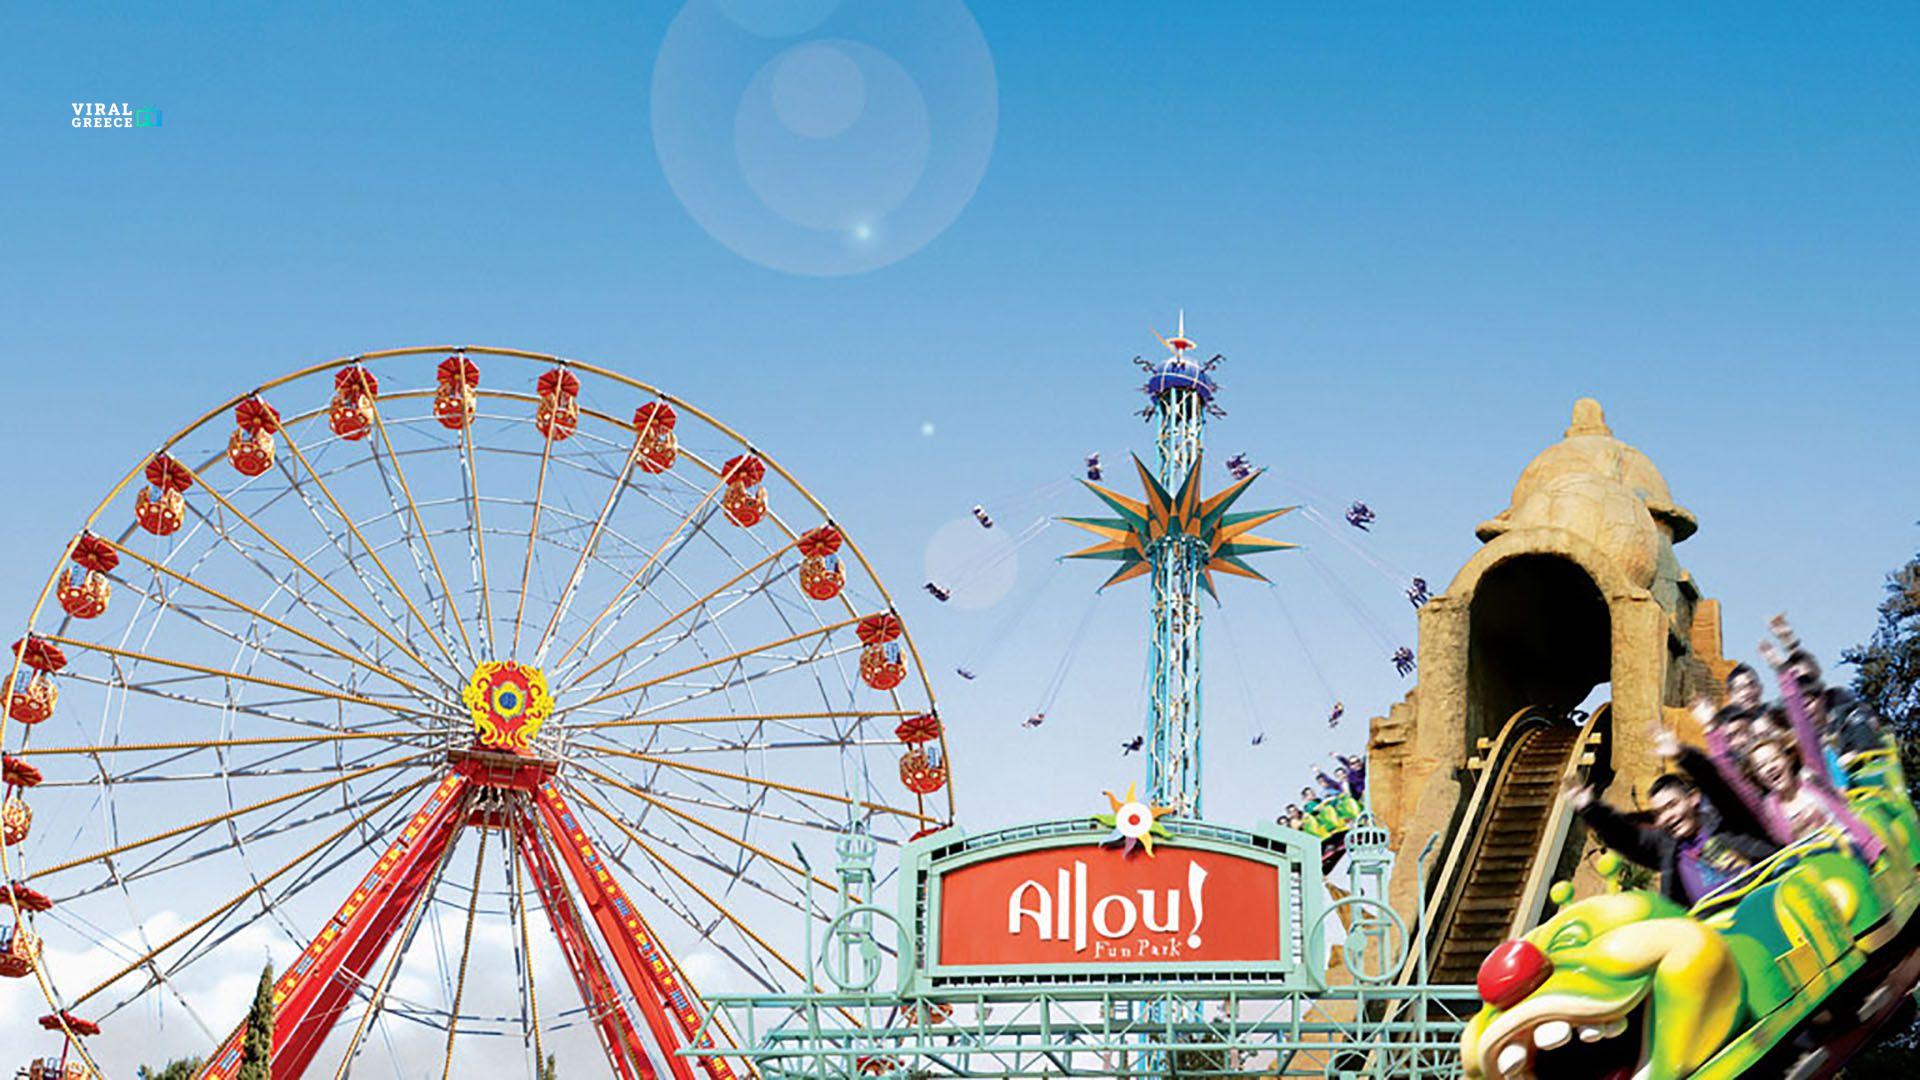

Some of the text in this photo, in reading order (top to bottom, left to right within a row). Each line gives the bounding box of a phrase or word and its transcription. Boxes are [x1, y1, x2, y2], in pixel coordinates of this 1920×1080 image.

[1008, 860, 1208, 952] Allou!
[1094, 937, 1182, 958] Fun Park
